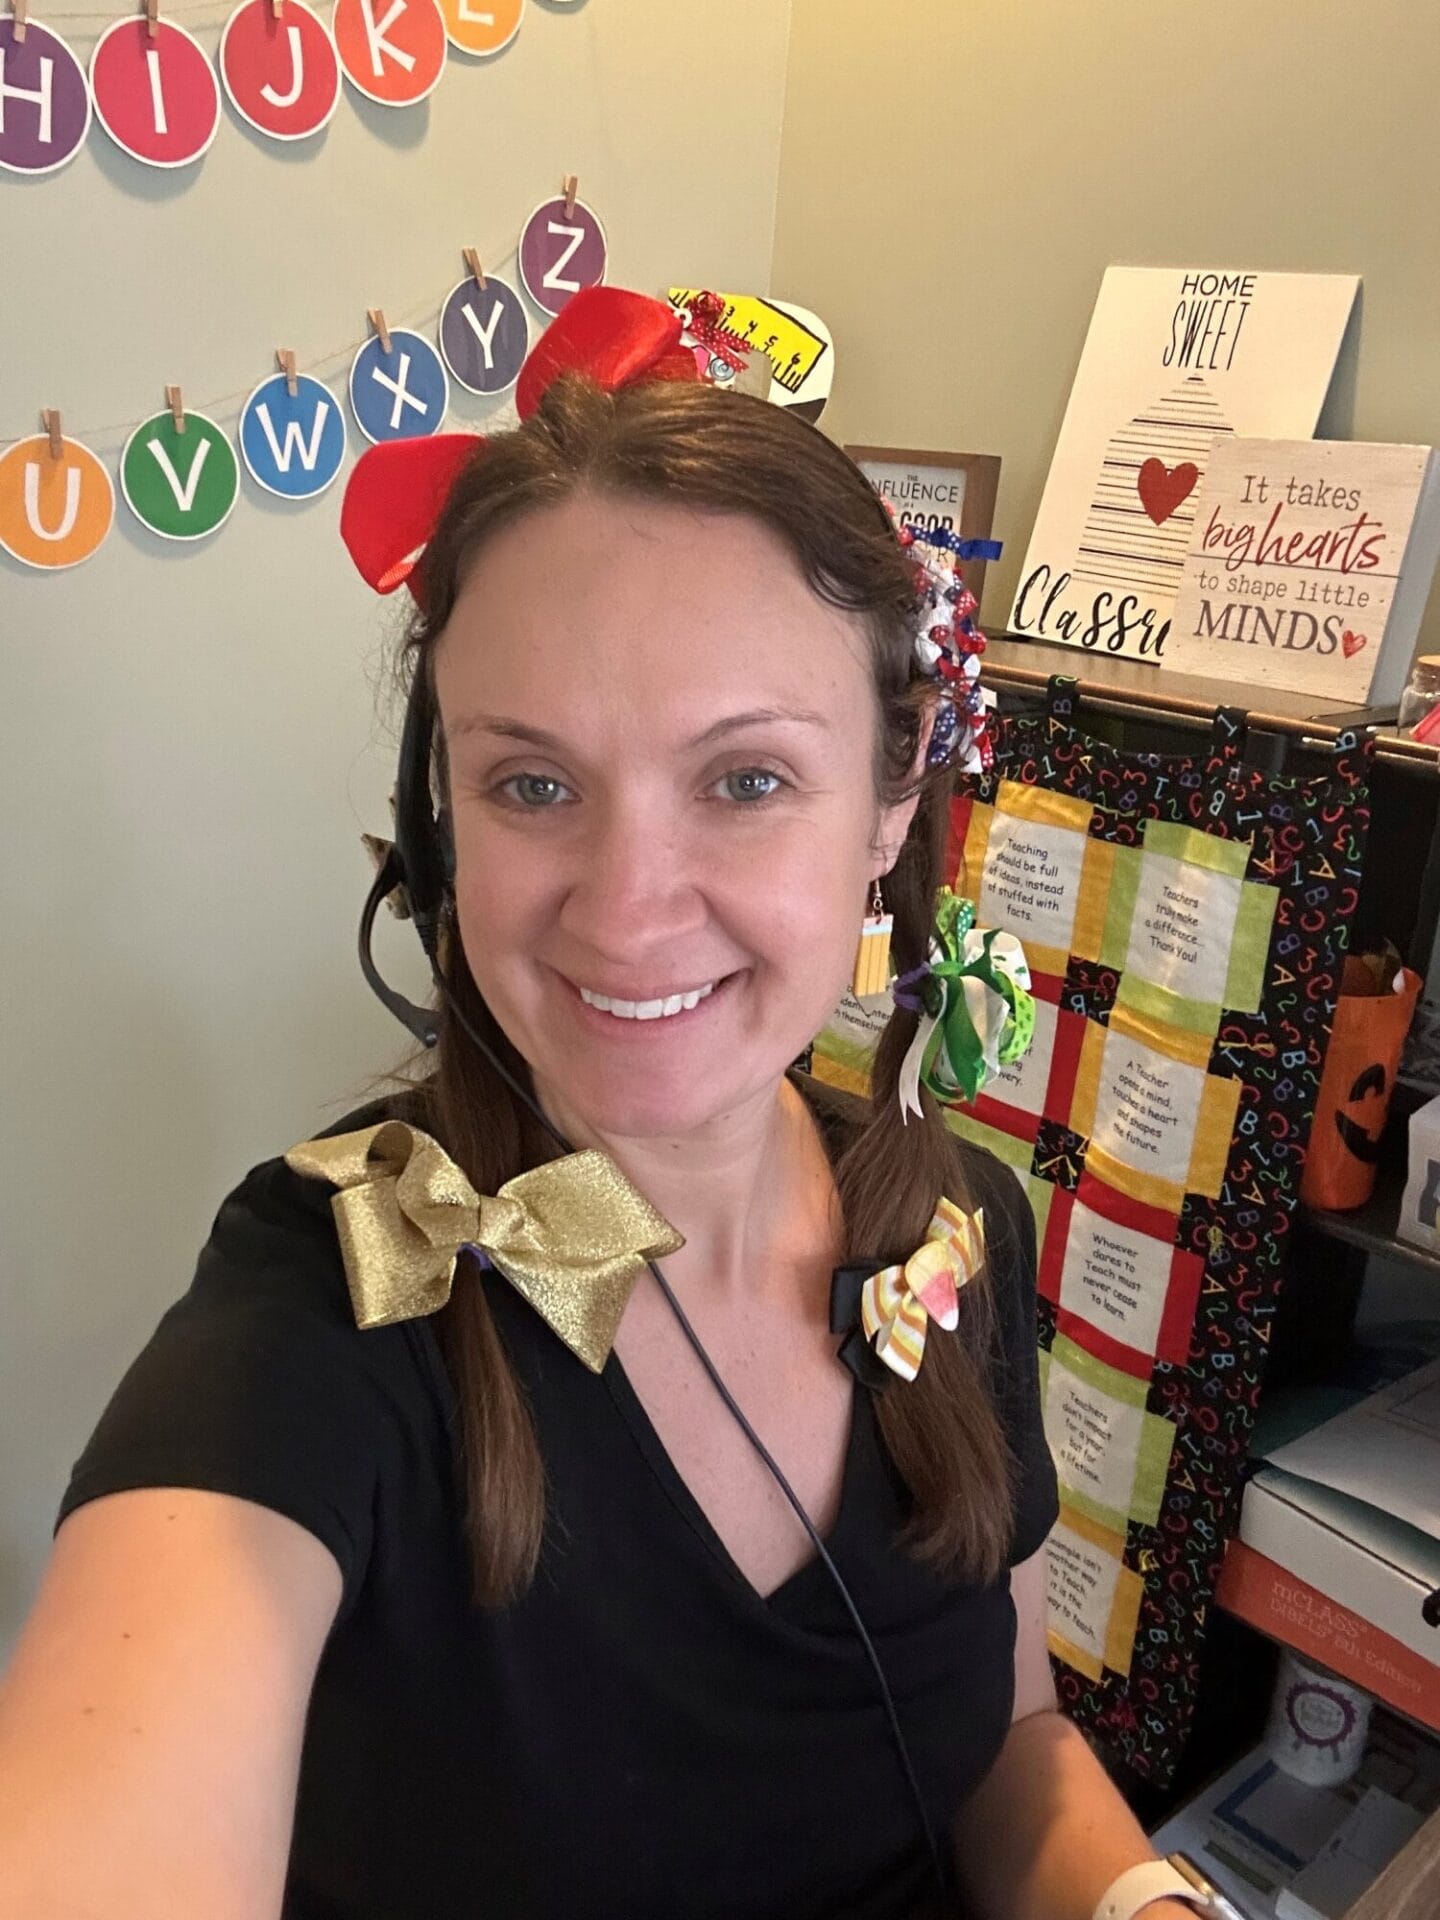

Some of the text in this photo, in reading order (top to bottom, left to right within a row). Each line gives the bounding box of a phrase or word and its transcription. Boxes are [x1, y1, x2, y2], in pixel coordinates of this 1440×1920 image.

[0, 47, 53, 143] H
[146, 50, 167, 134] I
[260, 26, 304, 107] J
[366, 0, 417, 77] K
[1181, 274, 1257, 297] HOME
[726, 306, 801, 366] 3 4 5 6
[1162, 300, 1251, 371] SWEET
[24, 221, 585, 541] U V W X Y Z
[870, 479, 959, 503] NFLUENCE
[1240, 475, 1361, 511] It takes
[1198, 573, 1370, 608] to shape little
[1193, 600, 1345, 655] MINDS
[1008, 838, 1048, 860] Teaching
[1023, 860, 1036, 873] be
[1040, 864, 1058, 877] full
[998, 887, 1033, 905] stuffed
[1036, 898, 1059, 911] with
[1025, 878, 1064, 896] instead
[1163, 886, 1199, 909] Teachers
[1007, 904, 1033, 922] facts.
[1144, 920, 1151, 928] a
[1175, 910, 1199, 927] make
[1150, 935, 1198, 964] Thank You!
[1126, 1061, 1169, 1089] A Teacher
[1129, 1117, 1162, 1139] shapes
[1148, 1107, 1178, 1126] heart
[1126, 1130, 1160, 1154] future.
[1093, 1233, 1138, 1258] Whoever
[1093, 1249, 1135, 1273] dares to
[1083, 1276, 1111, 1293] never
[1085, 1259, 1141, 1291] Teach must
[1091, 1293, 1101, 1305] to
